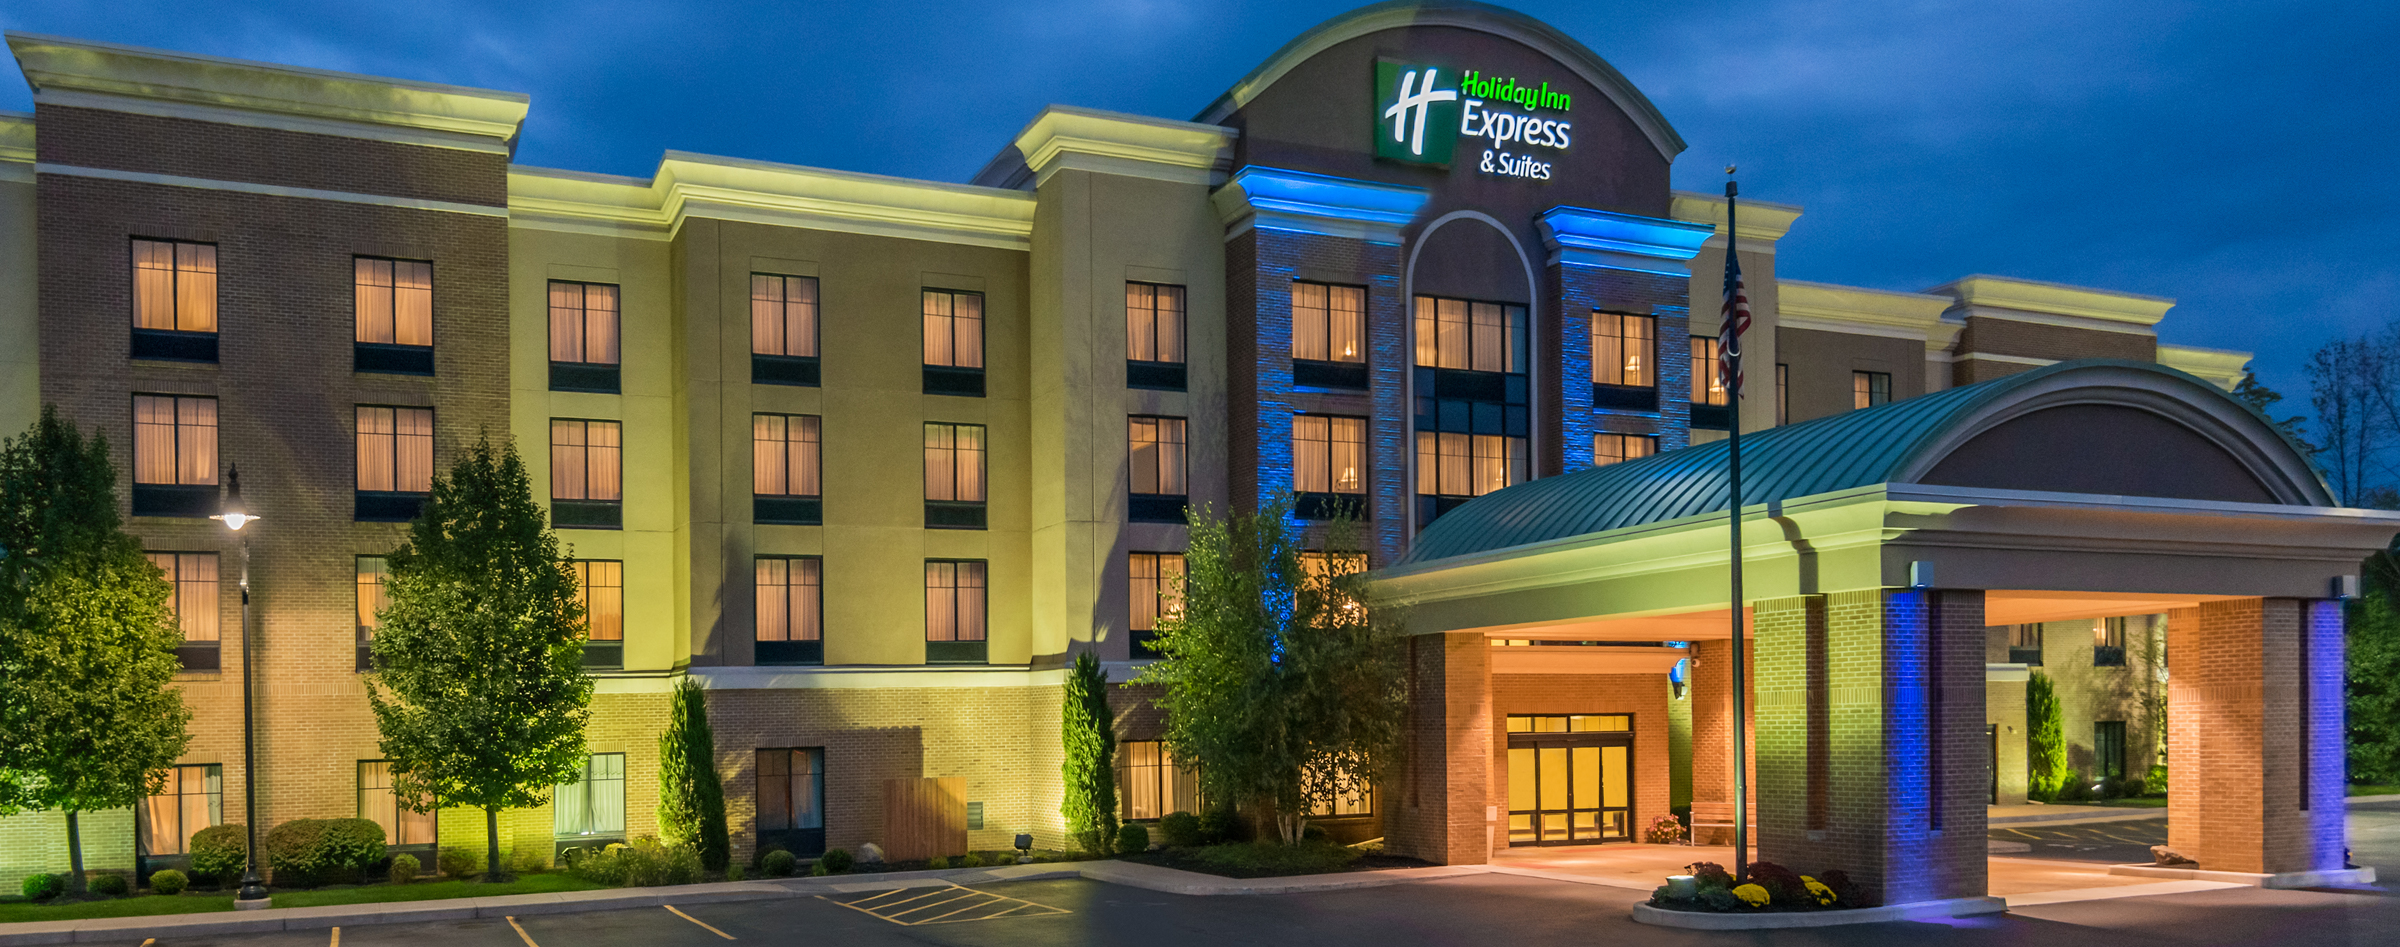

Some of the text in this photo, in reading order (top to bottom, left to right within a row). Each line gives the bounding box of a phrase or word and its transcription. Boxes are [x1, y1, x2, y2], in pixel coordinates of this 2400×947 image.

[1461, 70, 1571, 111] Holiday Inn
[1461, 99, 1571, 149] Express
[1480, 150, 1551, 180] & Suites
